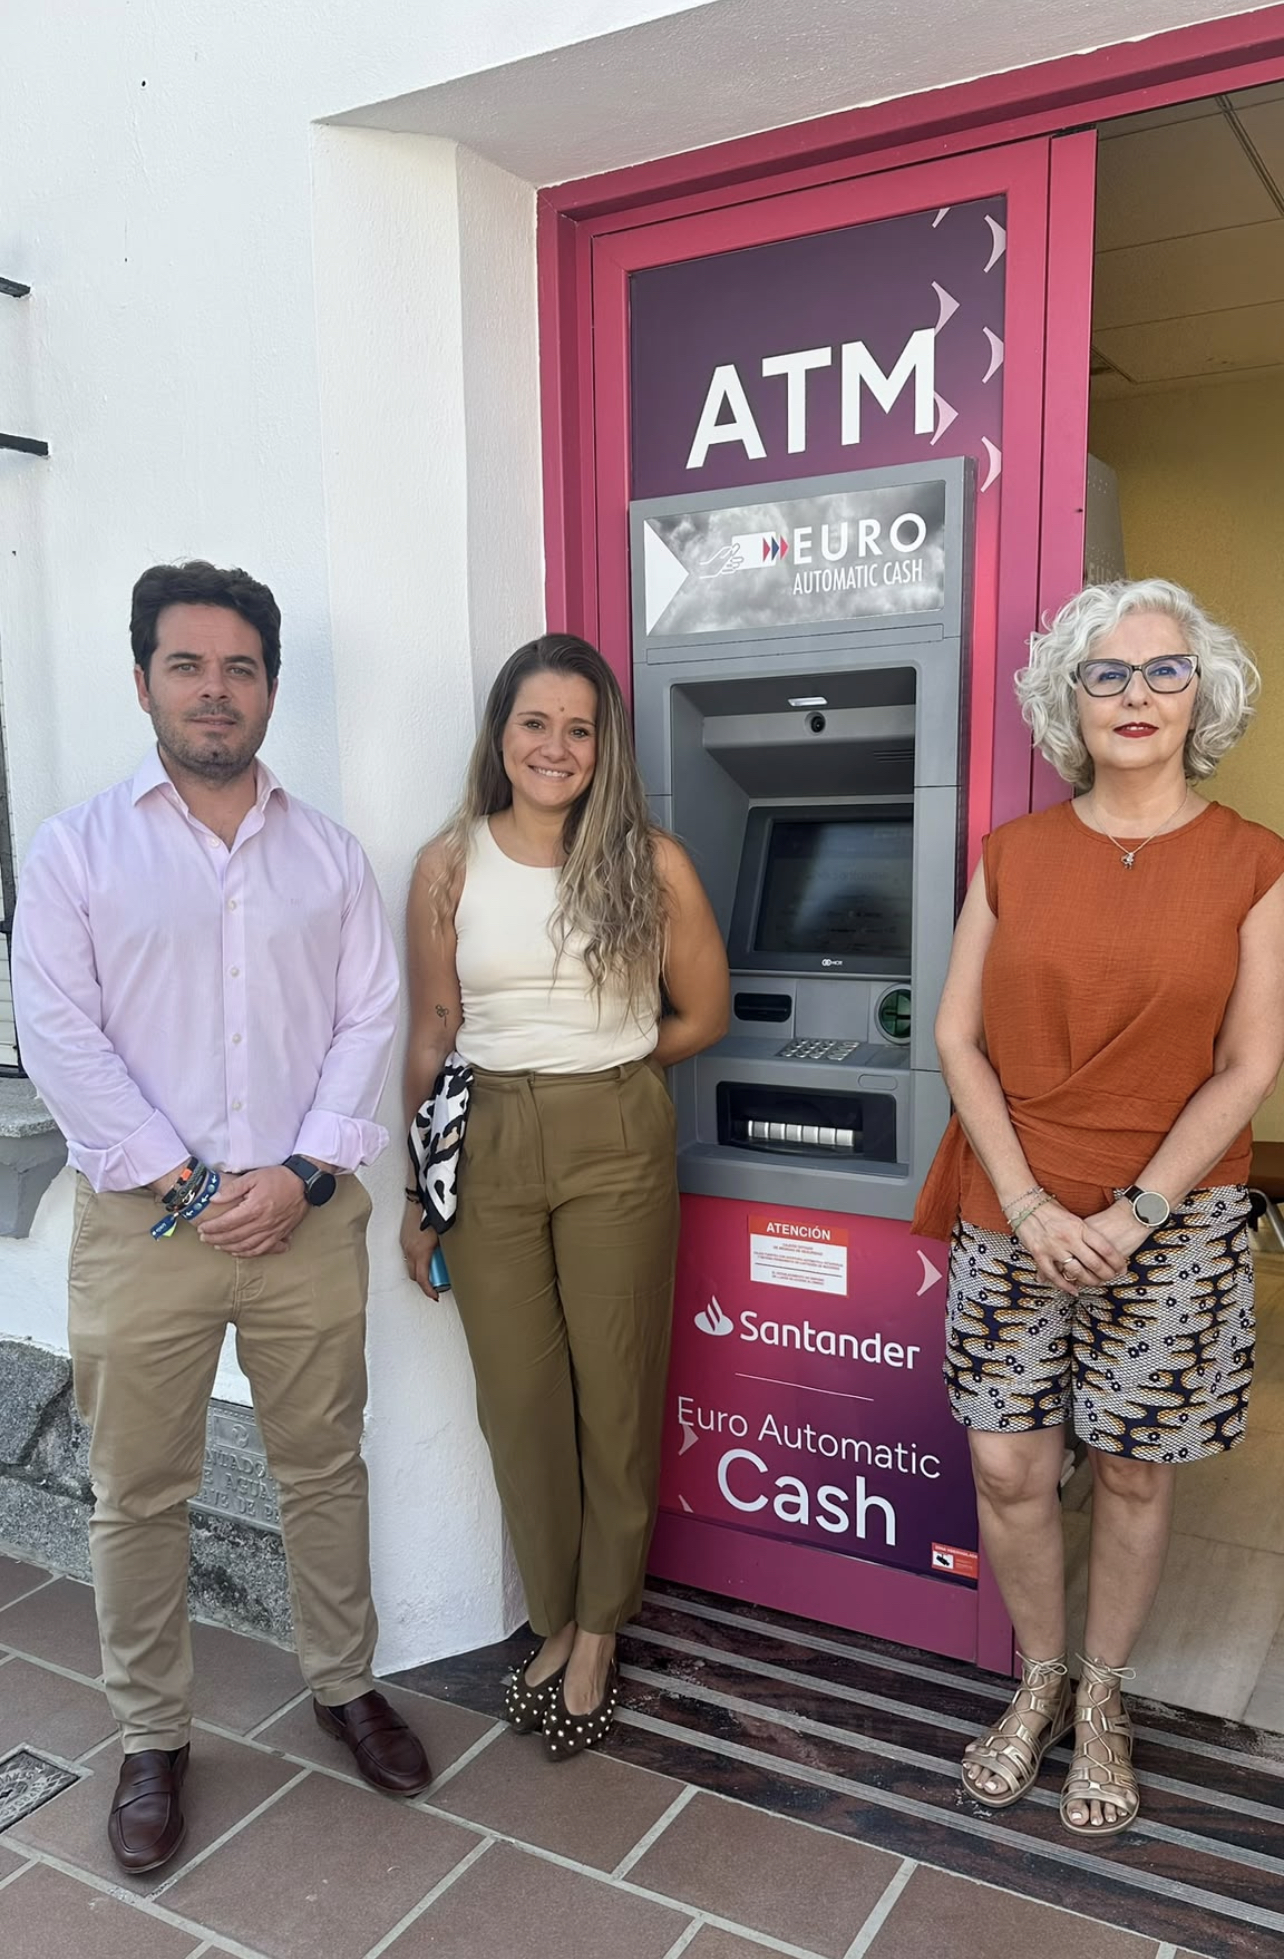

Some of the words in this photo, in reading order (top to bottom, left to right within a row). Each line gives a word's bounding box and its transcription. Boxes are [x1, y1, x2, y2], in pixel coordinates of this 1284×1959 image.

[686, 328, 935, 469] ATM
[793, 512, 927, 566] EURO
[792, 564, 878, 596] AUTOMATIC
[882, 558, 923, 588] CASH
[766, 1222, 831, 1241] ATENCIÓN
[740, 1310, 920, 1369] Santander
[678, 1396, 748, 1437] Euro
[758, 1414, 941, 1479] Automatic
[717, 1448, 896, 1546] Cash
